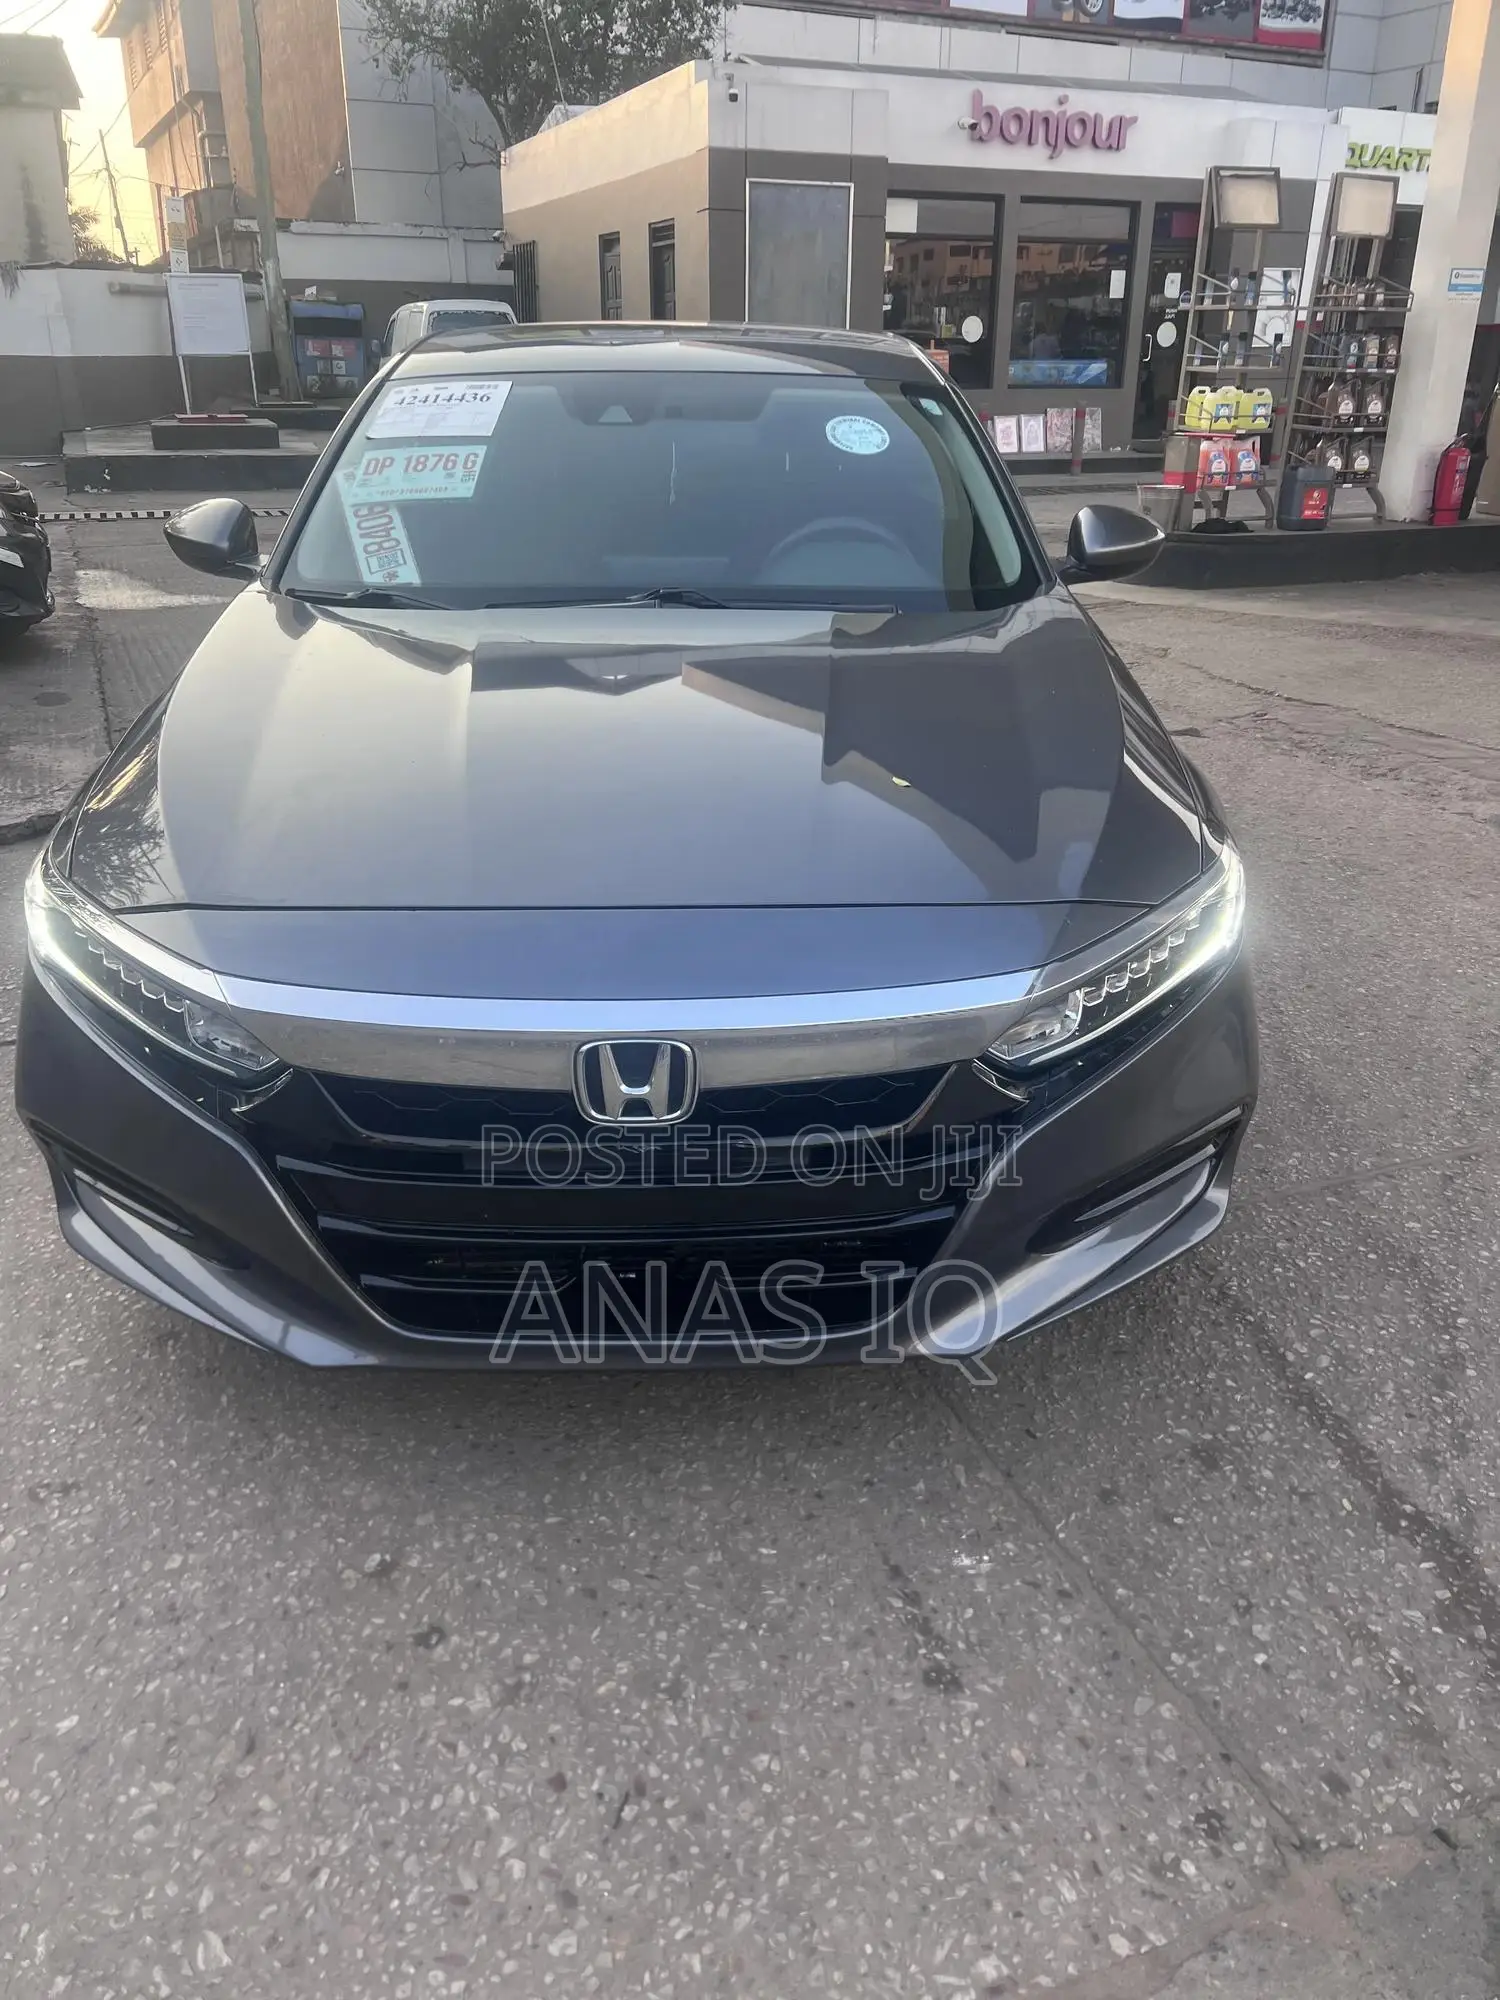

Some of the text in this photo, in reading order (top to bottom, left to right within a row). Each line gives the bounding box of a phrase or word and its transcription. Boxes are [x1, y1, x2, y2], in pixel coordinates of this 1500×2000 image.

[971, 88, 1139, 160] bonjour
[1345, 142, 1431, 172] QUART
[394, 392, 492, 406] 42414436
[362, 452, 479, 476] DP 1876 G
